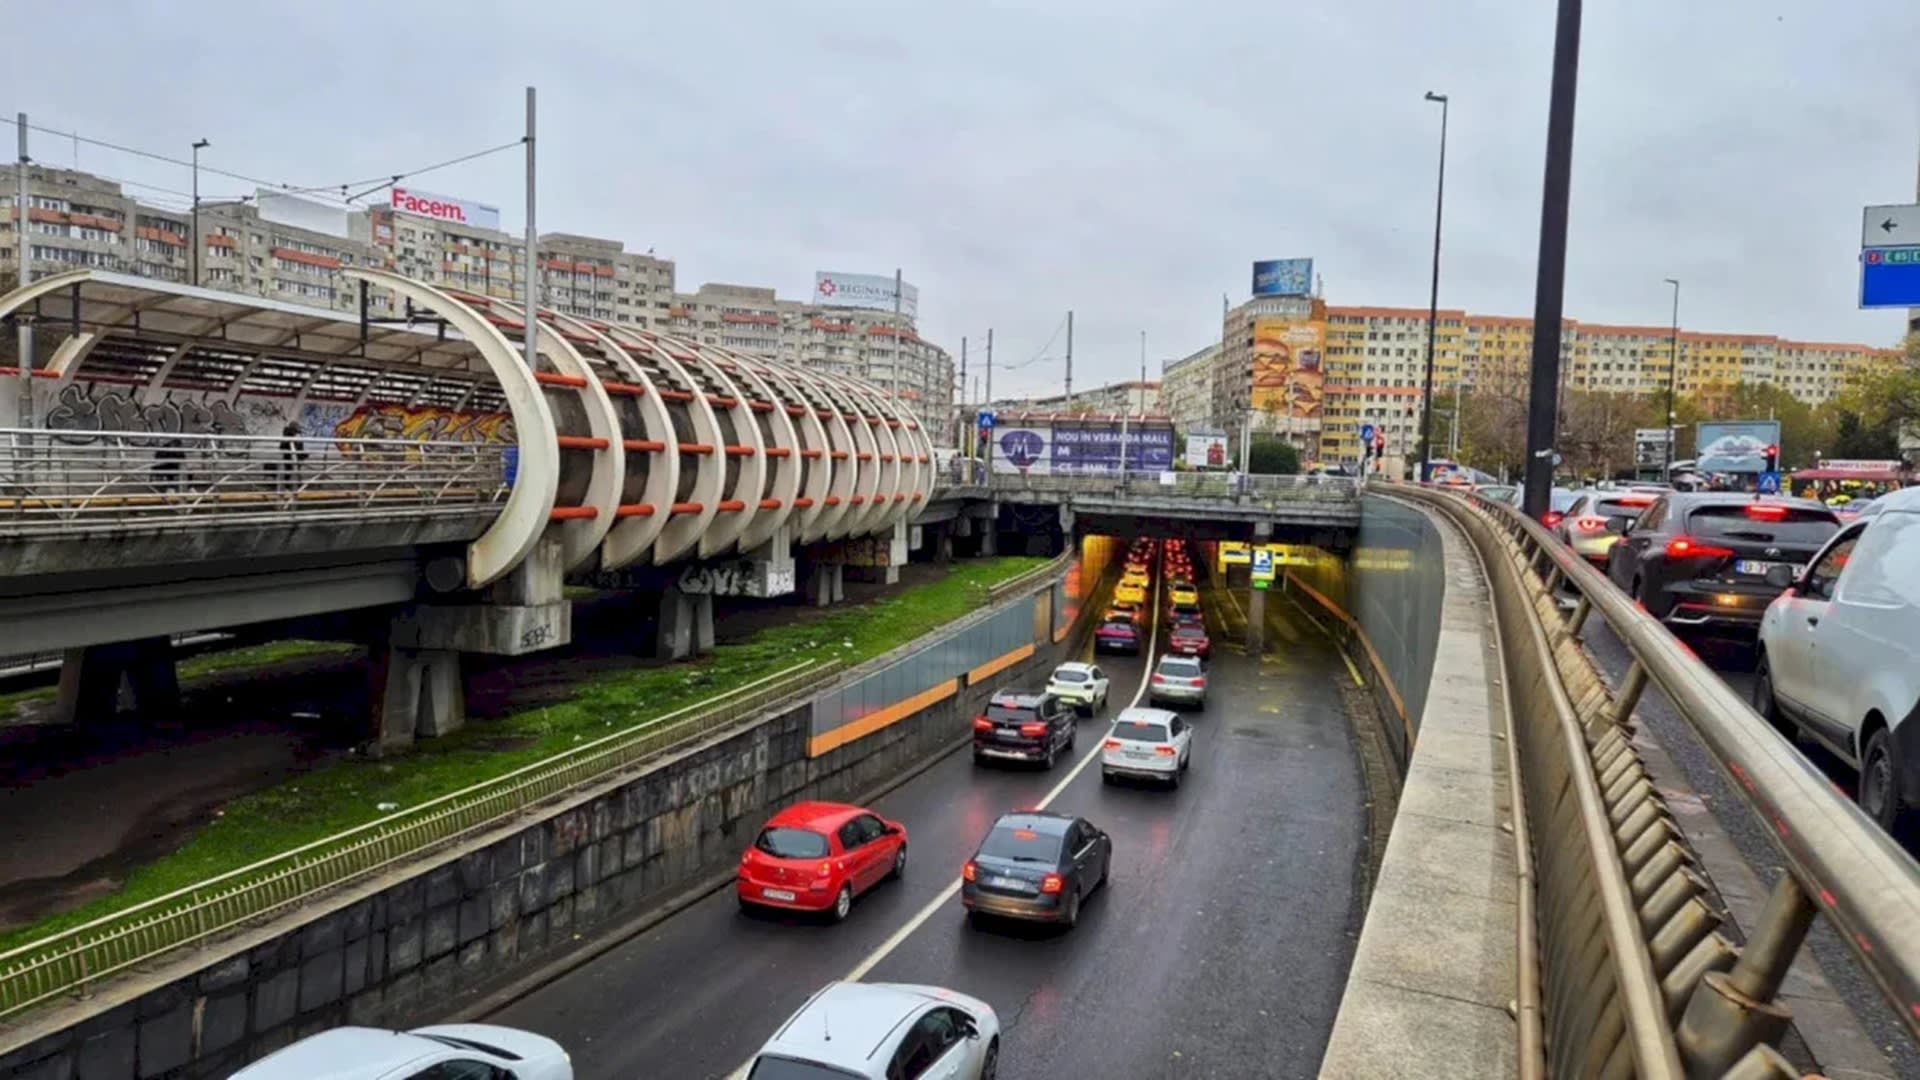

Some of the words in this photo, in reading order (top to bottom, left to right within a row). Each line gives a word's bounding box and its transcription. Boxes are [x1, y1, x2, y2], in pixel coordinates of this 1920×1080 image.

[392, 188, 466, 221] Facem.
[1056, 432, 1079, 442] NOU
[1142, 435, 1169, 444] MALL
[1254, 550, 1268, 565] P
